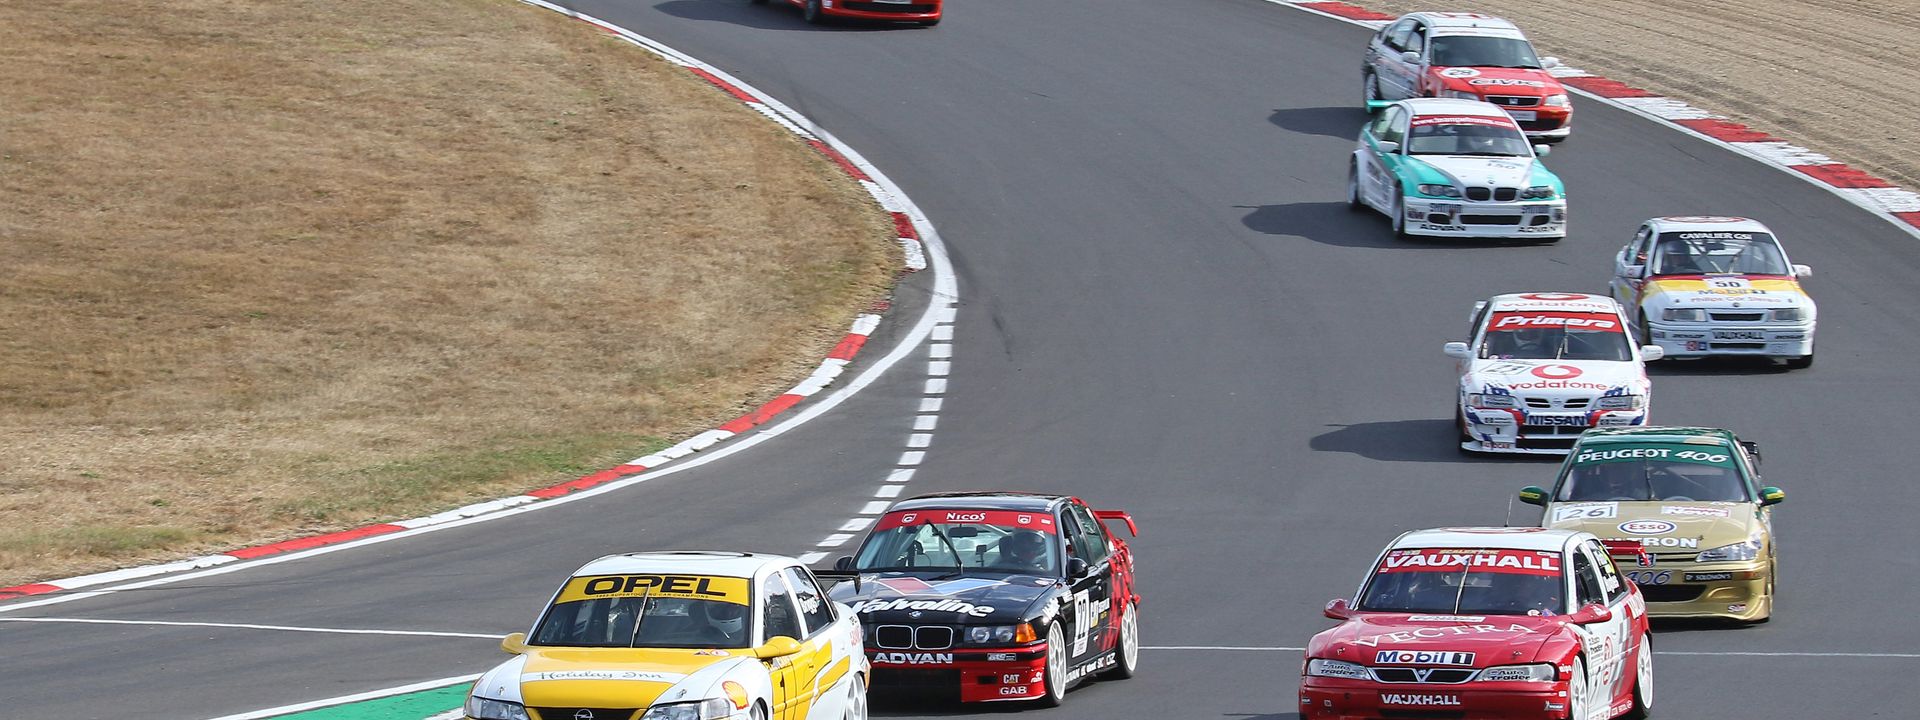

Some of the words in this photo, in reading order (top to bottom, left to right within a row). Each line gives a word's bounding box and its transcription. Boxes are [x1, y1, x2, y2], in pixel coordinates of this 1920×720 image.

[1419, 224, 1466, 232] ADVAN
[1501, 301, 1610, 309] vodafone
[1495, 315, 1616, 329] Primera
[1712, 331, 1765, 340] VAUXHALL
[1508, 380, 1608, 390] vodafone
[1528, 415, 1586, 426] NISSAN
[1577, 449, 1672, 463] PEUGEOT
[1674, 450, 1730, 463] 406
[1386, 554, 1560, 571] VAUXHALL
[584, 576, 726, 596] OPEL
[850, 598, 995, 618] Valvoline
[1352, 622, 1540, 648] VECTRA
[872, 652, 954, 664] ADVAN
[1376, 651, 1447, 664] Mobil
[538, 670, 613, 680] Holiday
[622, 671, 664, 679] Inn
[1003, 674, 1020, 684] CAT
[999, 686, 1027, 695] GAB
[1380, 693, 1461, 705] VAUXHALL
